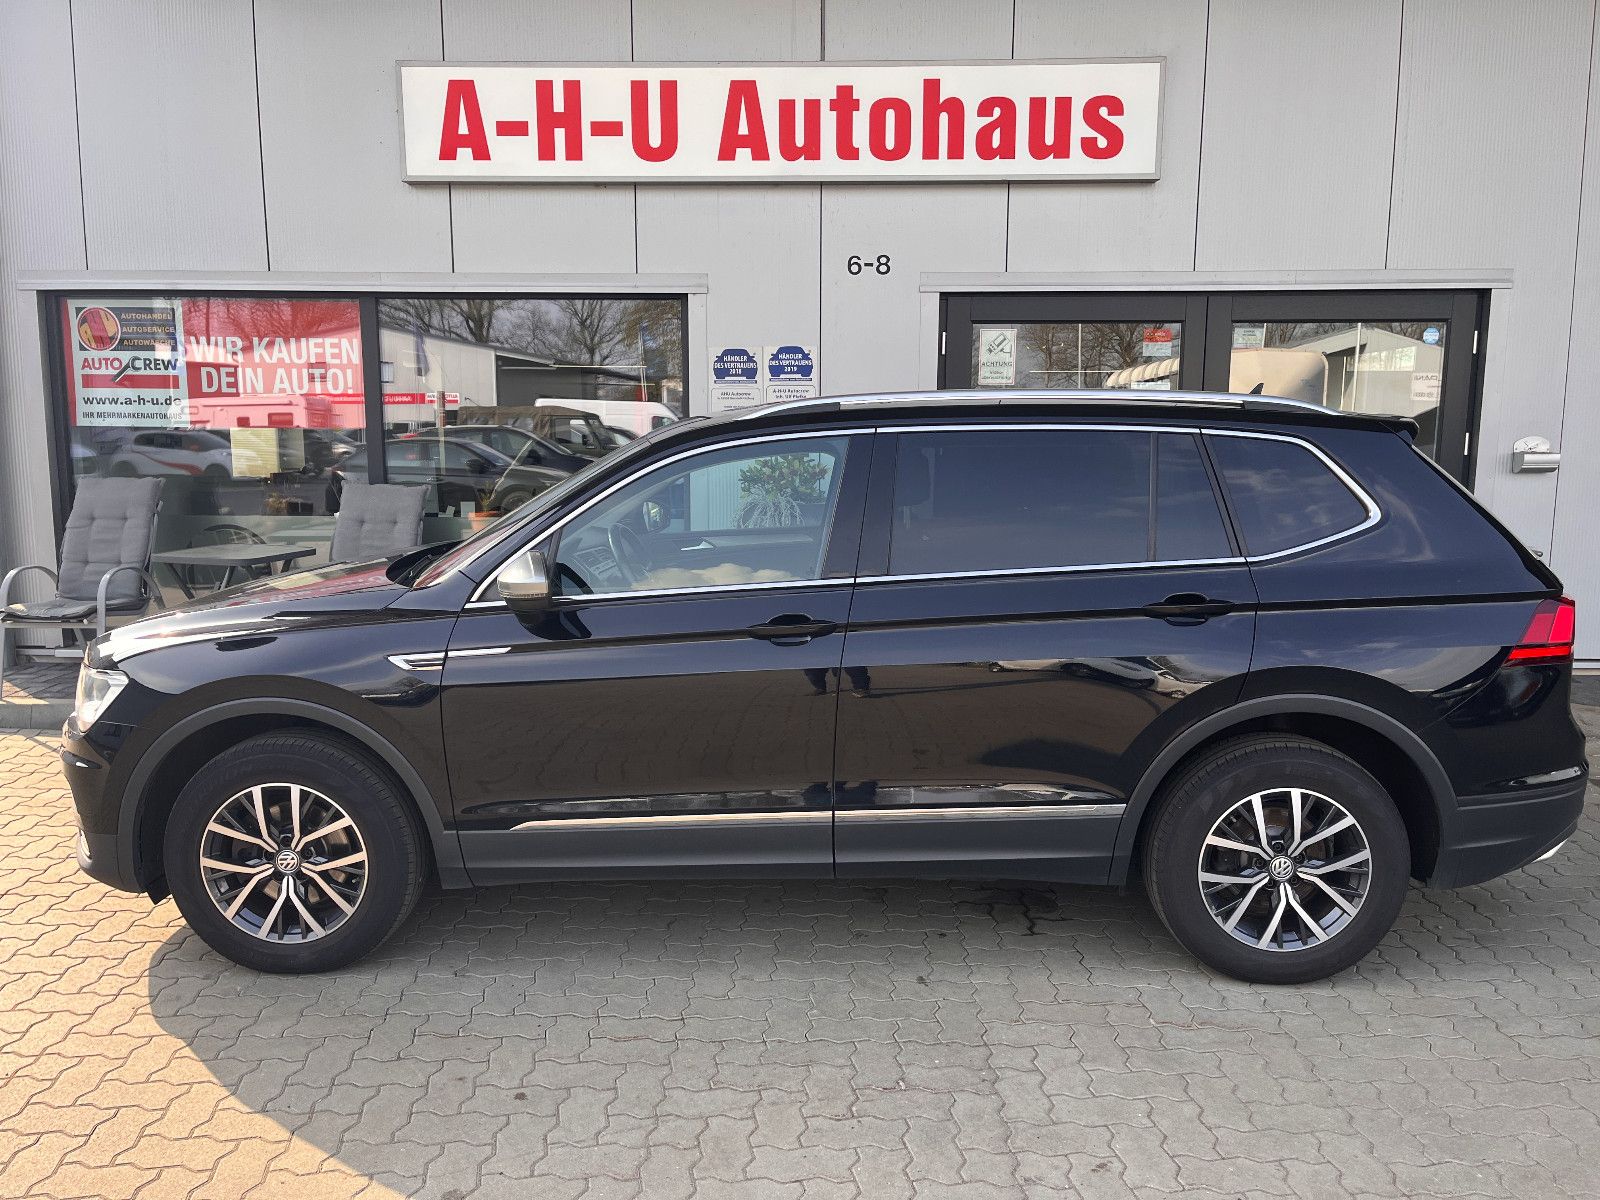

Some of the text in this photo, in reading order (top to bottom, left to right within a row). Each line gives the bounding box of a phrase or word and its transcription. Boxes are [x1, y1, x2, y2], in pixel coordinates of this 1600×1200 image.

[438, 77, 1125, 162] A-H-U Autohaus
[848, 254, 890, 275] 6-8
[189, 336, 359, 365] WIR KAUFEN
[81, 356, 178, 371] AUTO CREW
[200, 367, 354, 395] DEIN AUTO!
[82, 394, 182, 406] www.a-h-u.de
[82, 411, 183, 421] IHR MEHRMARKENAUTOHAUS
